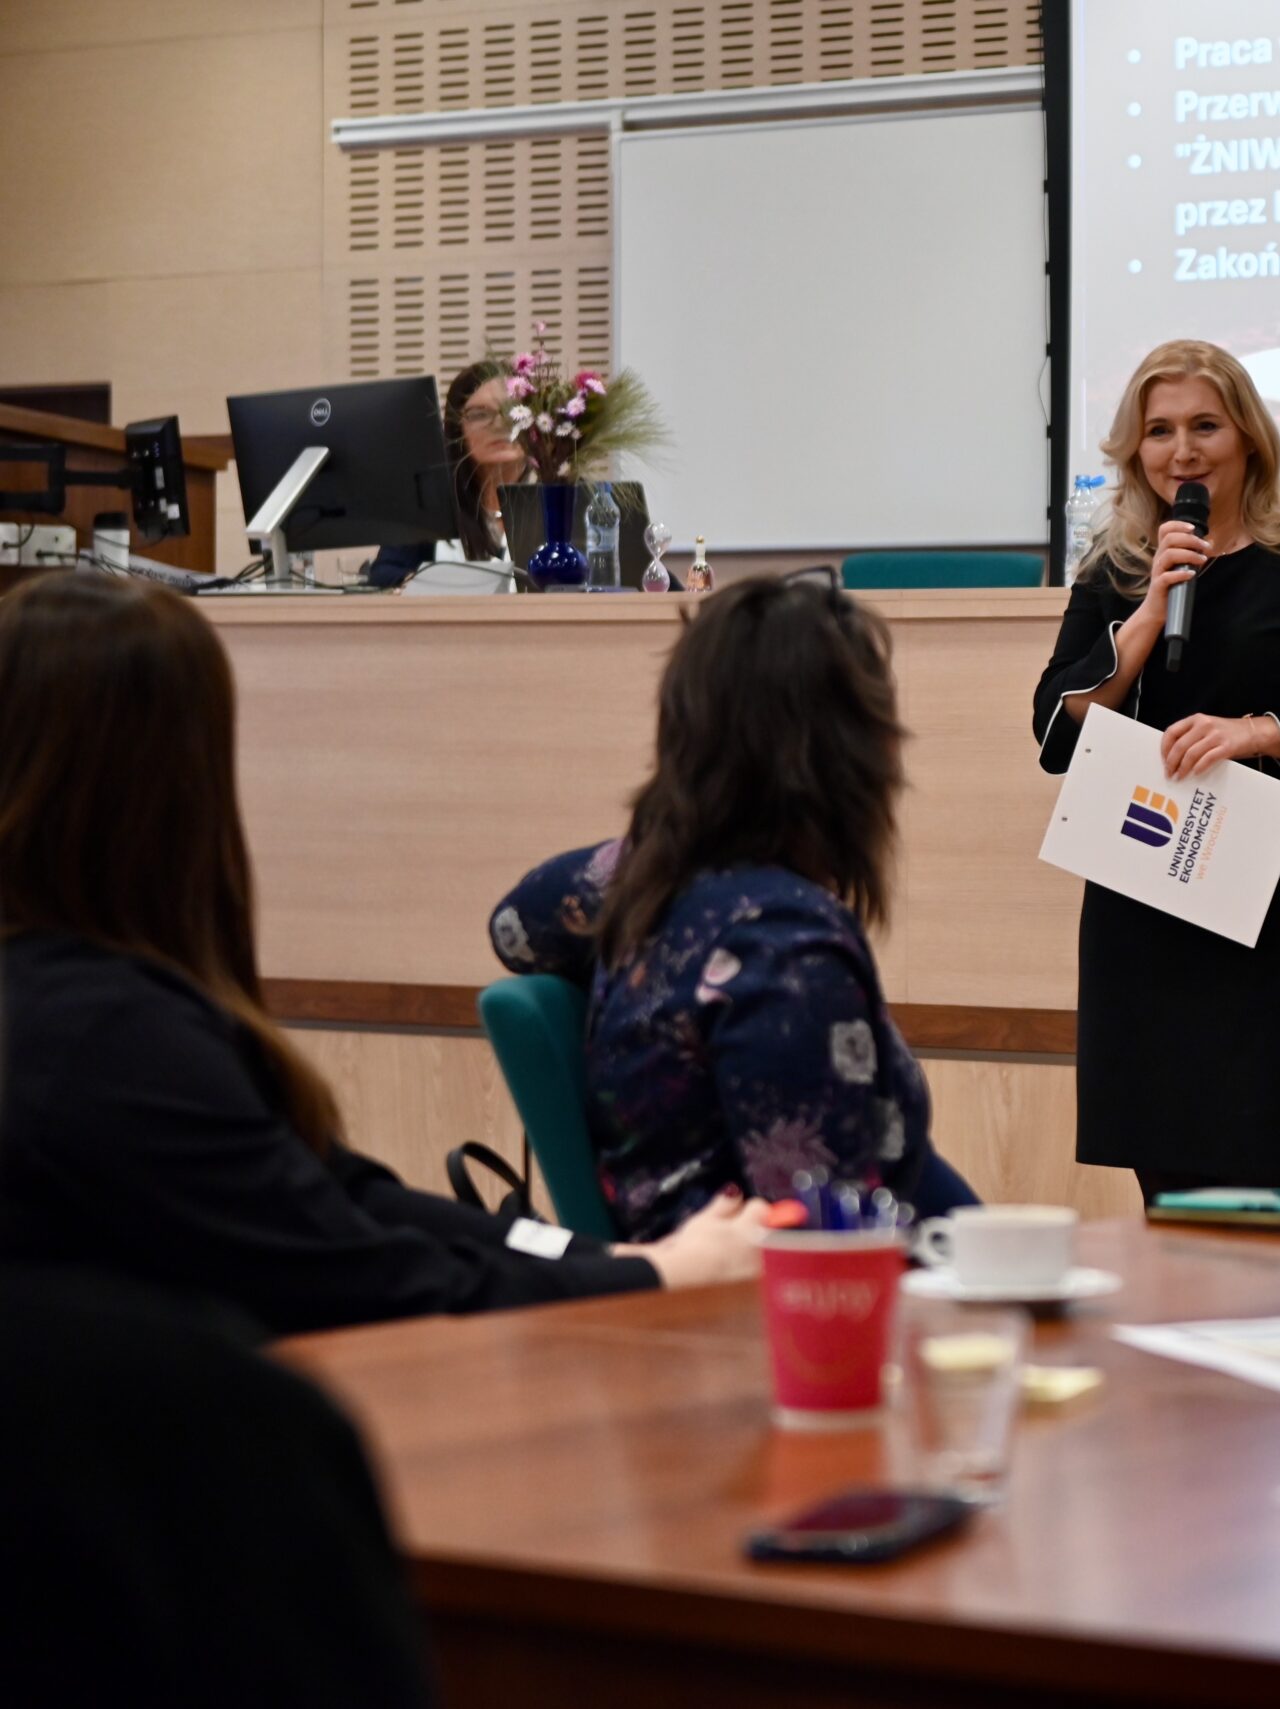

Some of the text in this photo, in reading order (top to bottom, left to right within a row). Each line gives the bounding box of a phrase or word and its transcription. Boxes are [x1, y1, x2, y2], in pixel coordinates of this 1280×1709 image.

[1174, 35, 1273, 70] Praca
[1174, 195, 1266, 237] przez
[1168, 787, 1206, 877] UNIWERSYTET
[1179, 791, 1218, 884] EKONOMICZNY
